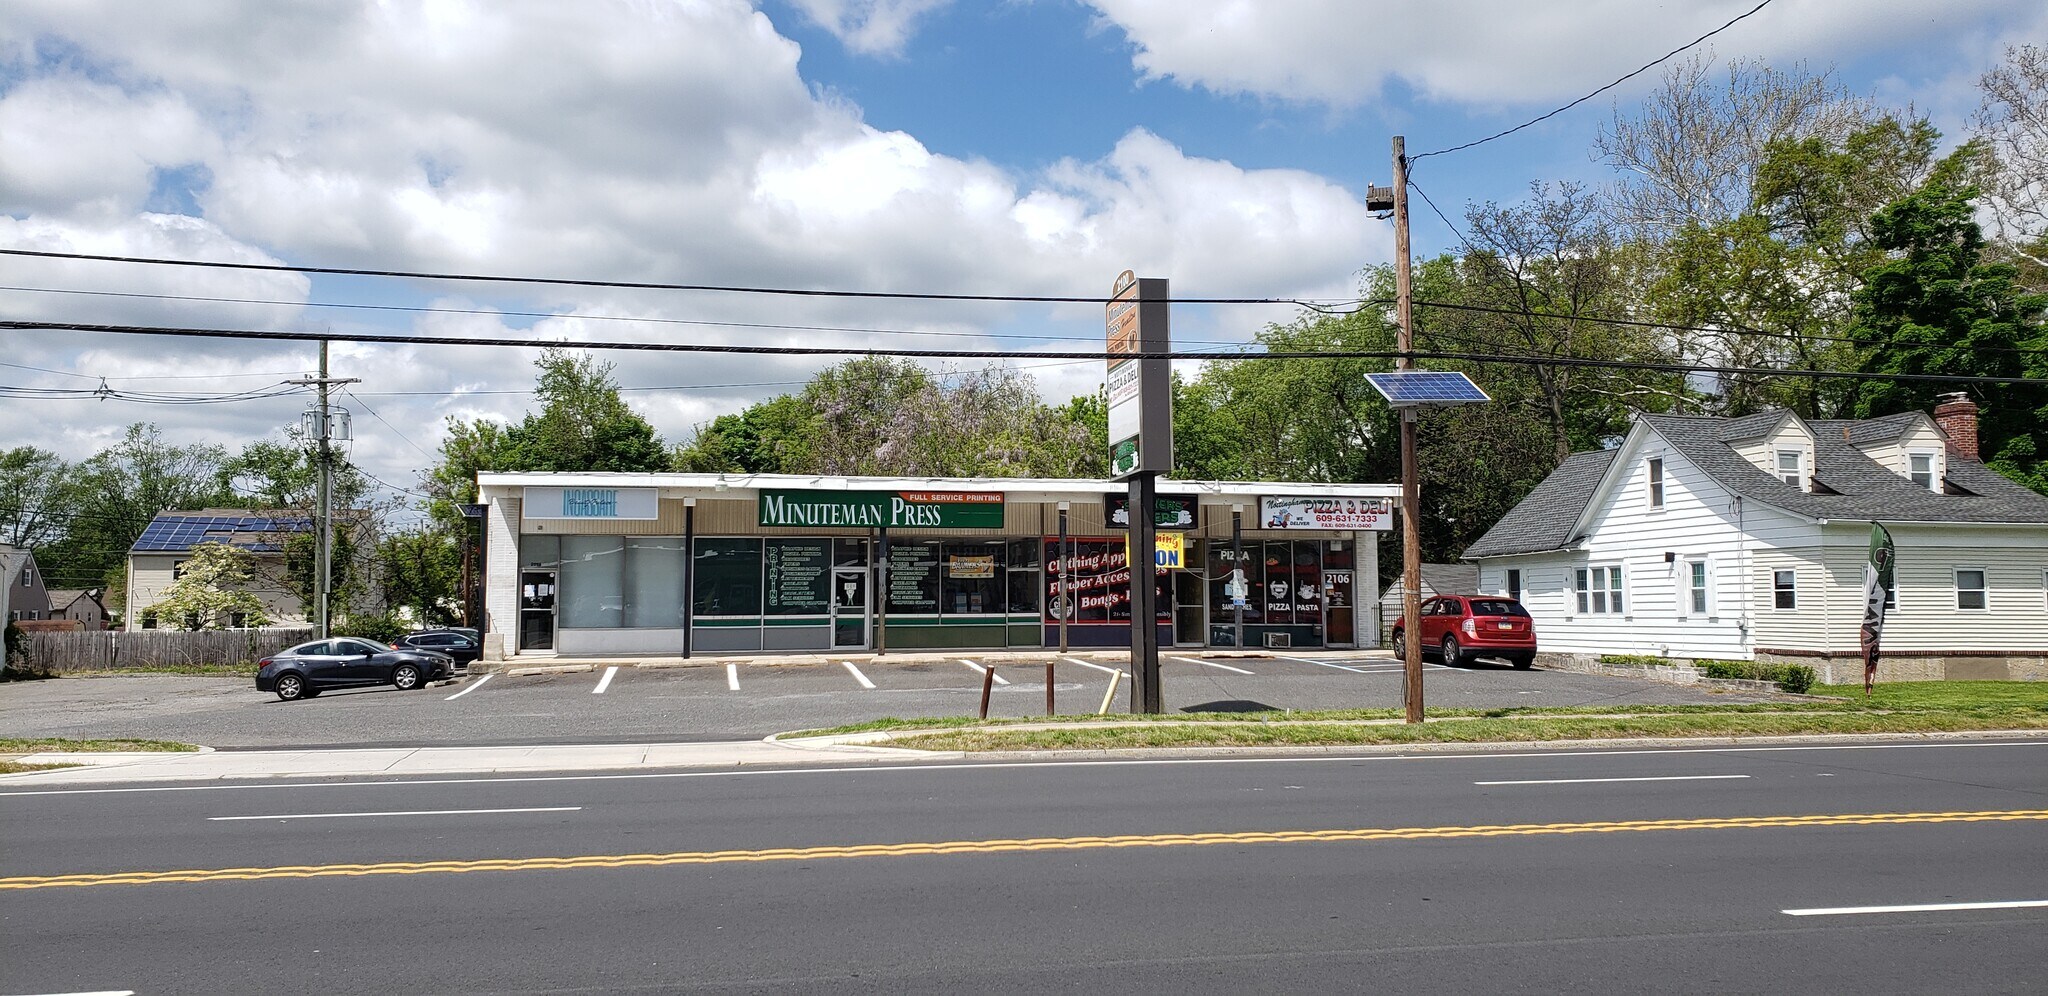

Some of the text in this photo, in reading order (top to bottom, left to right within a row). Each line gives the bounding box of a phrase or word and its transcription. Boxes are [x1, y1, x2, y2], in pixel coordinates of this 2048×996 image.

[1109, 376, 1123, 393] PIZZA
[1266, 498, 1305, 510] Nottingham
[1304, 500, 1389, 514] PIZZA & DELI
[1316, 515, 1378, 523] 609-631-7333
[1220, 550, 1250, 561] PIZA
[1048, 555, 1099, 571] Clthing
[769, 546, 779, 606] PRINTING
[1326, 574, 1350, 584] 2106
[1050, 578, 1092, 594] Flwer
[1081, 593, 1119, 608] Bongs
[1269, 603, 1291, 611] PIZZA
